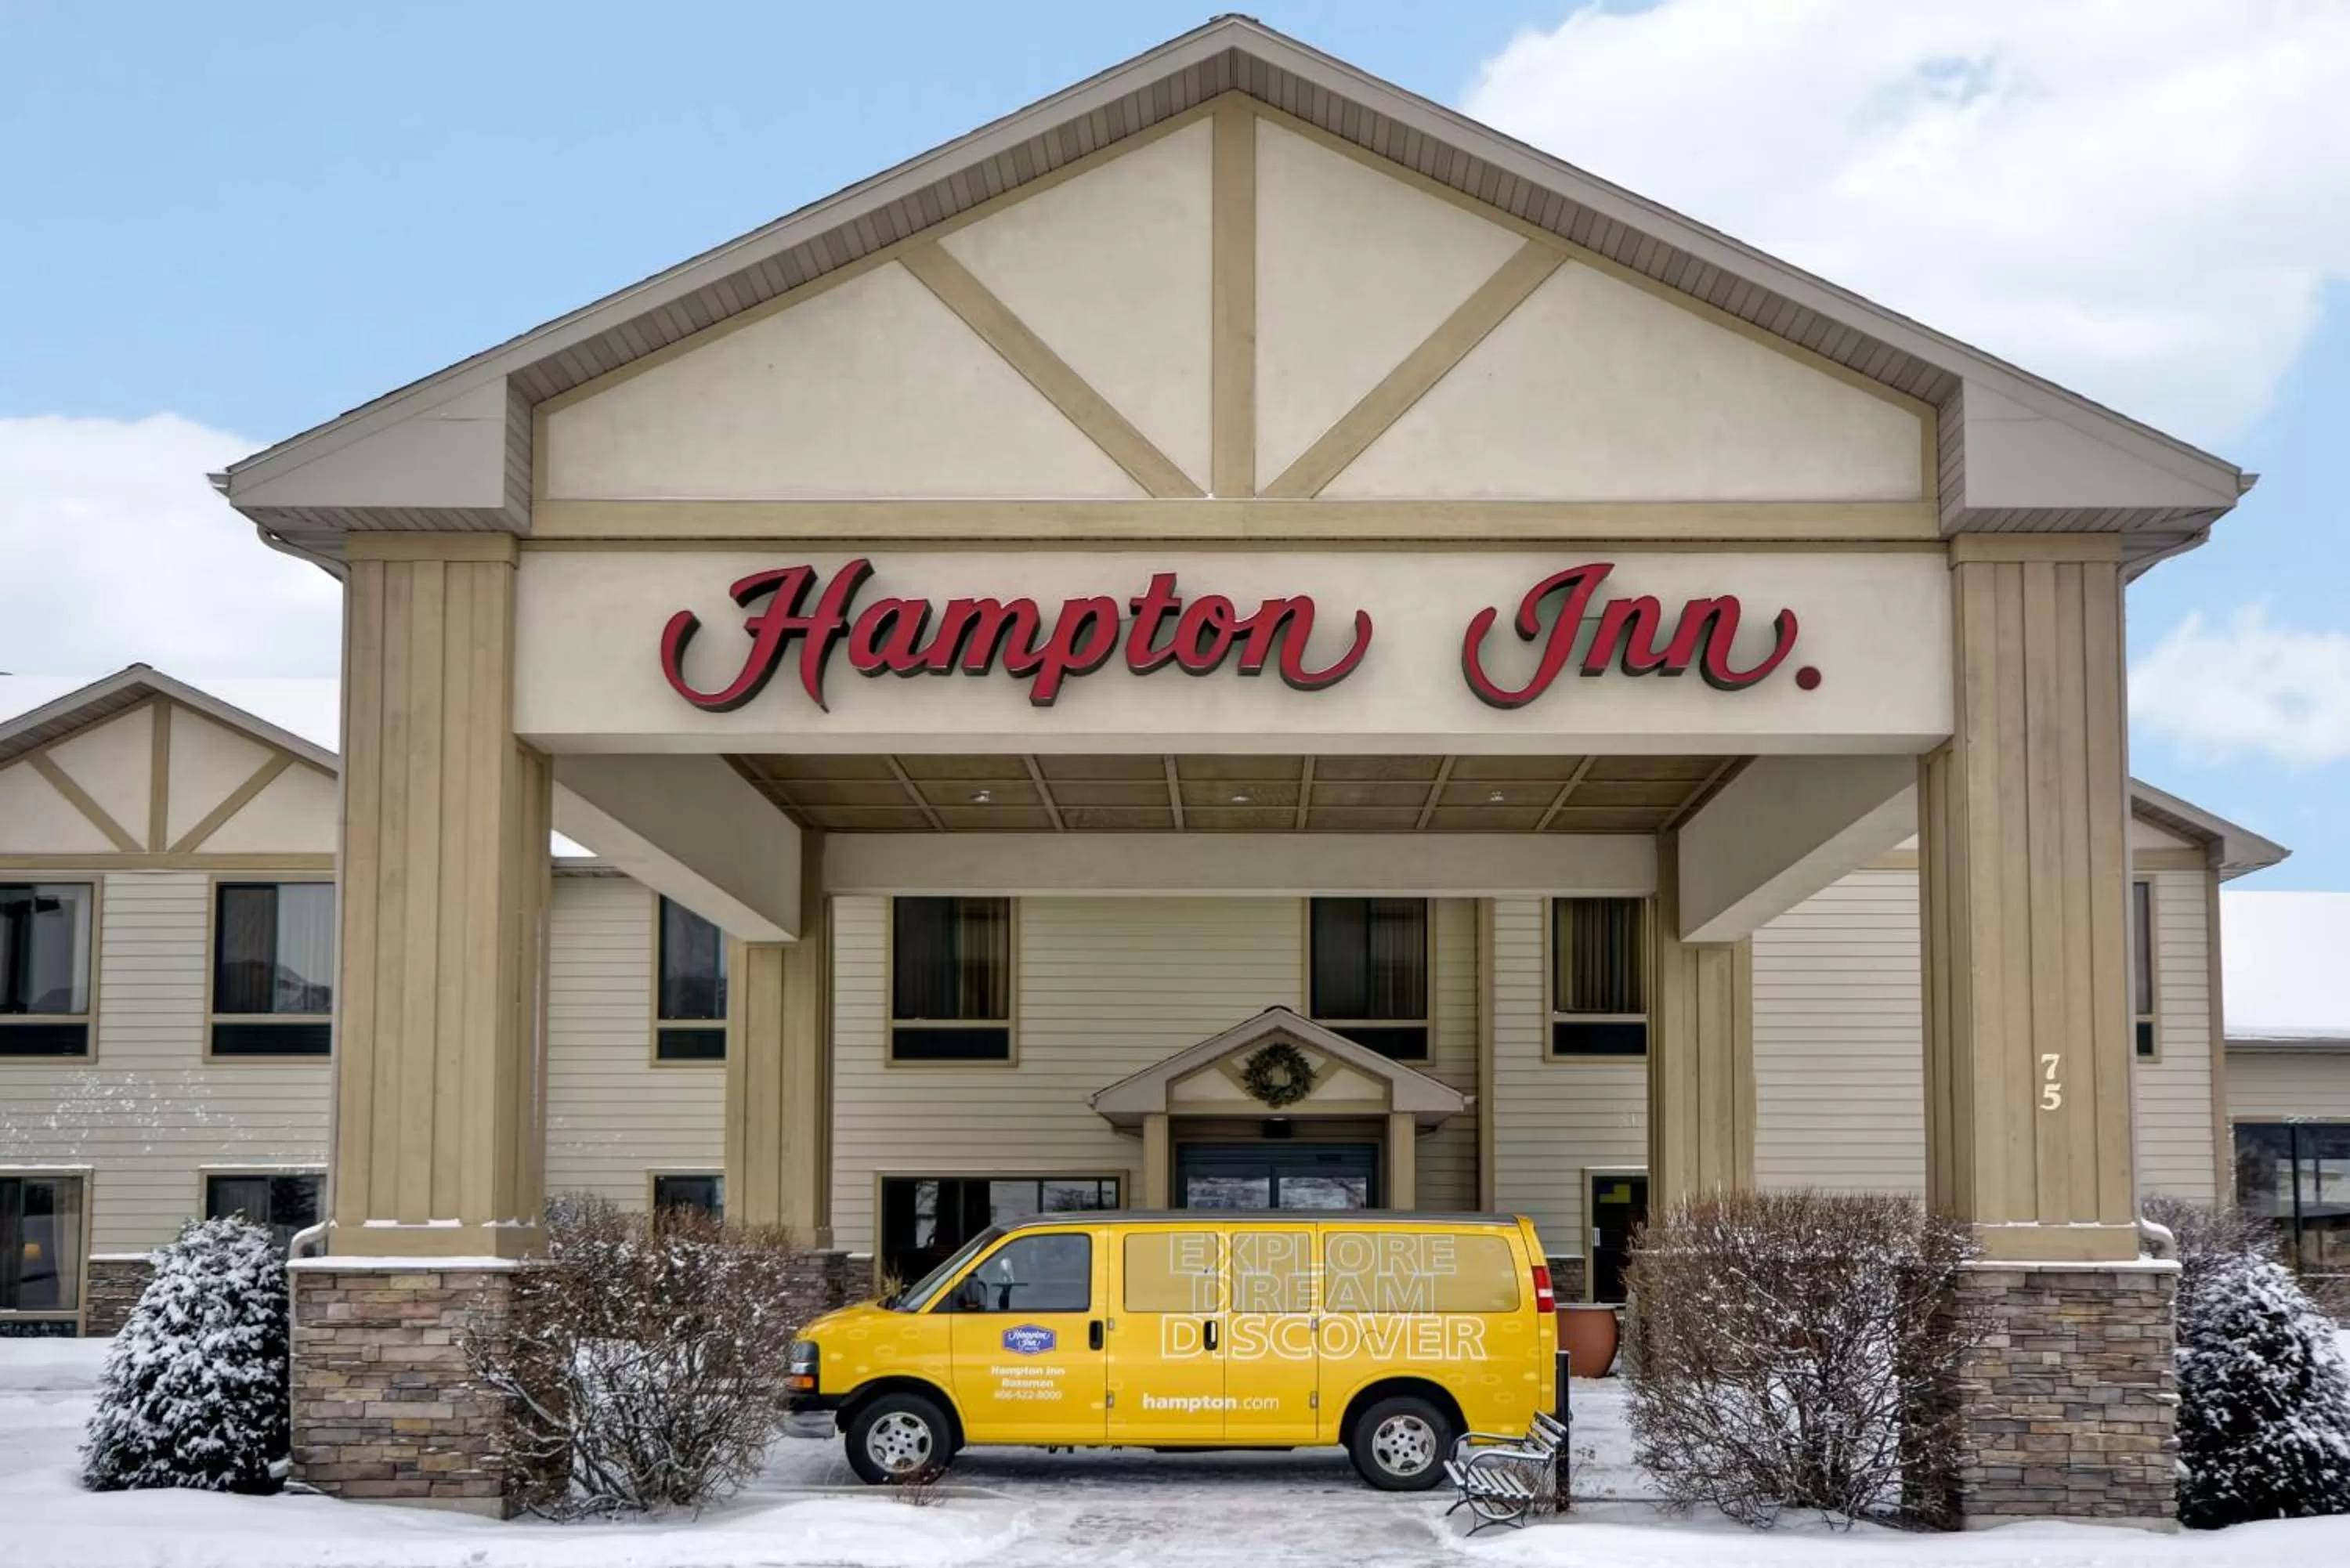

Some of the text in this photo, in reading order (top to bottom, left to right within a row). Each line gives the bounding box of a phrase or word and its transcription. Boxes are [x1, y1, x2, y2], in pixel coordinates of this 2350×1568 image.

[660, 558, 1373, 713] Hampton
[2039, 1053, 2062, 1111] 75
[1169, 1232, 1457, 1275] EXPLORE
[1192, 1272, 1435, 1317] DREAM
[1160, 1313, 1488, 1360] DISCOVER
[991, 1365, 1066, 1377] Hampton Inn
[1142, 1392, 1279, 1412] hampton.com
